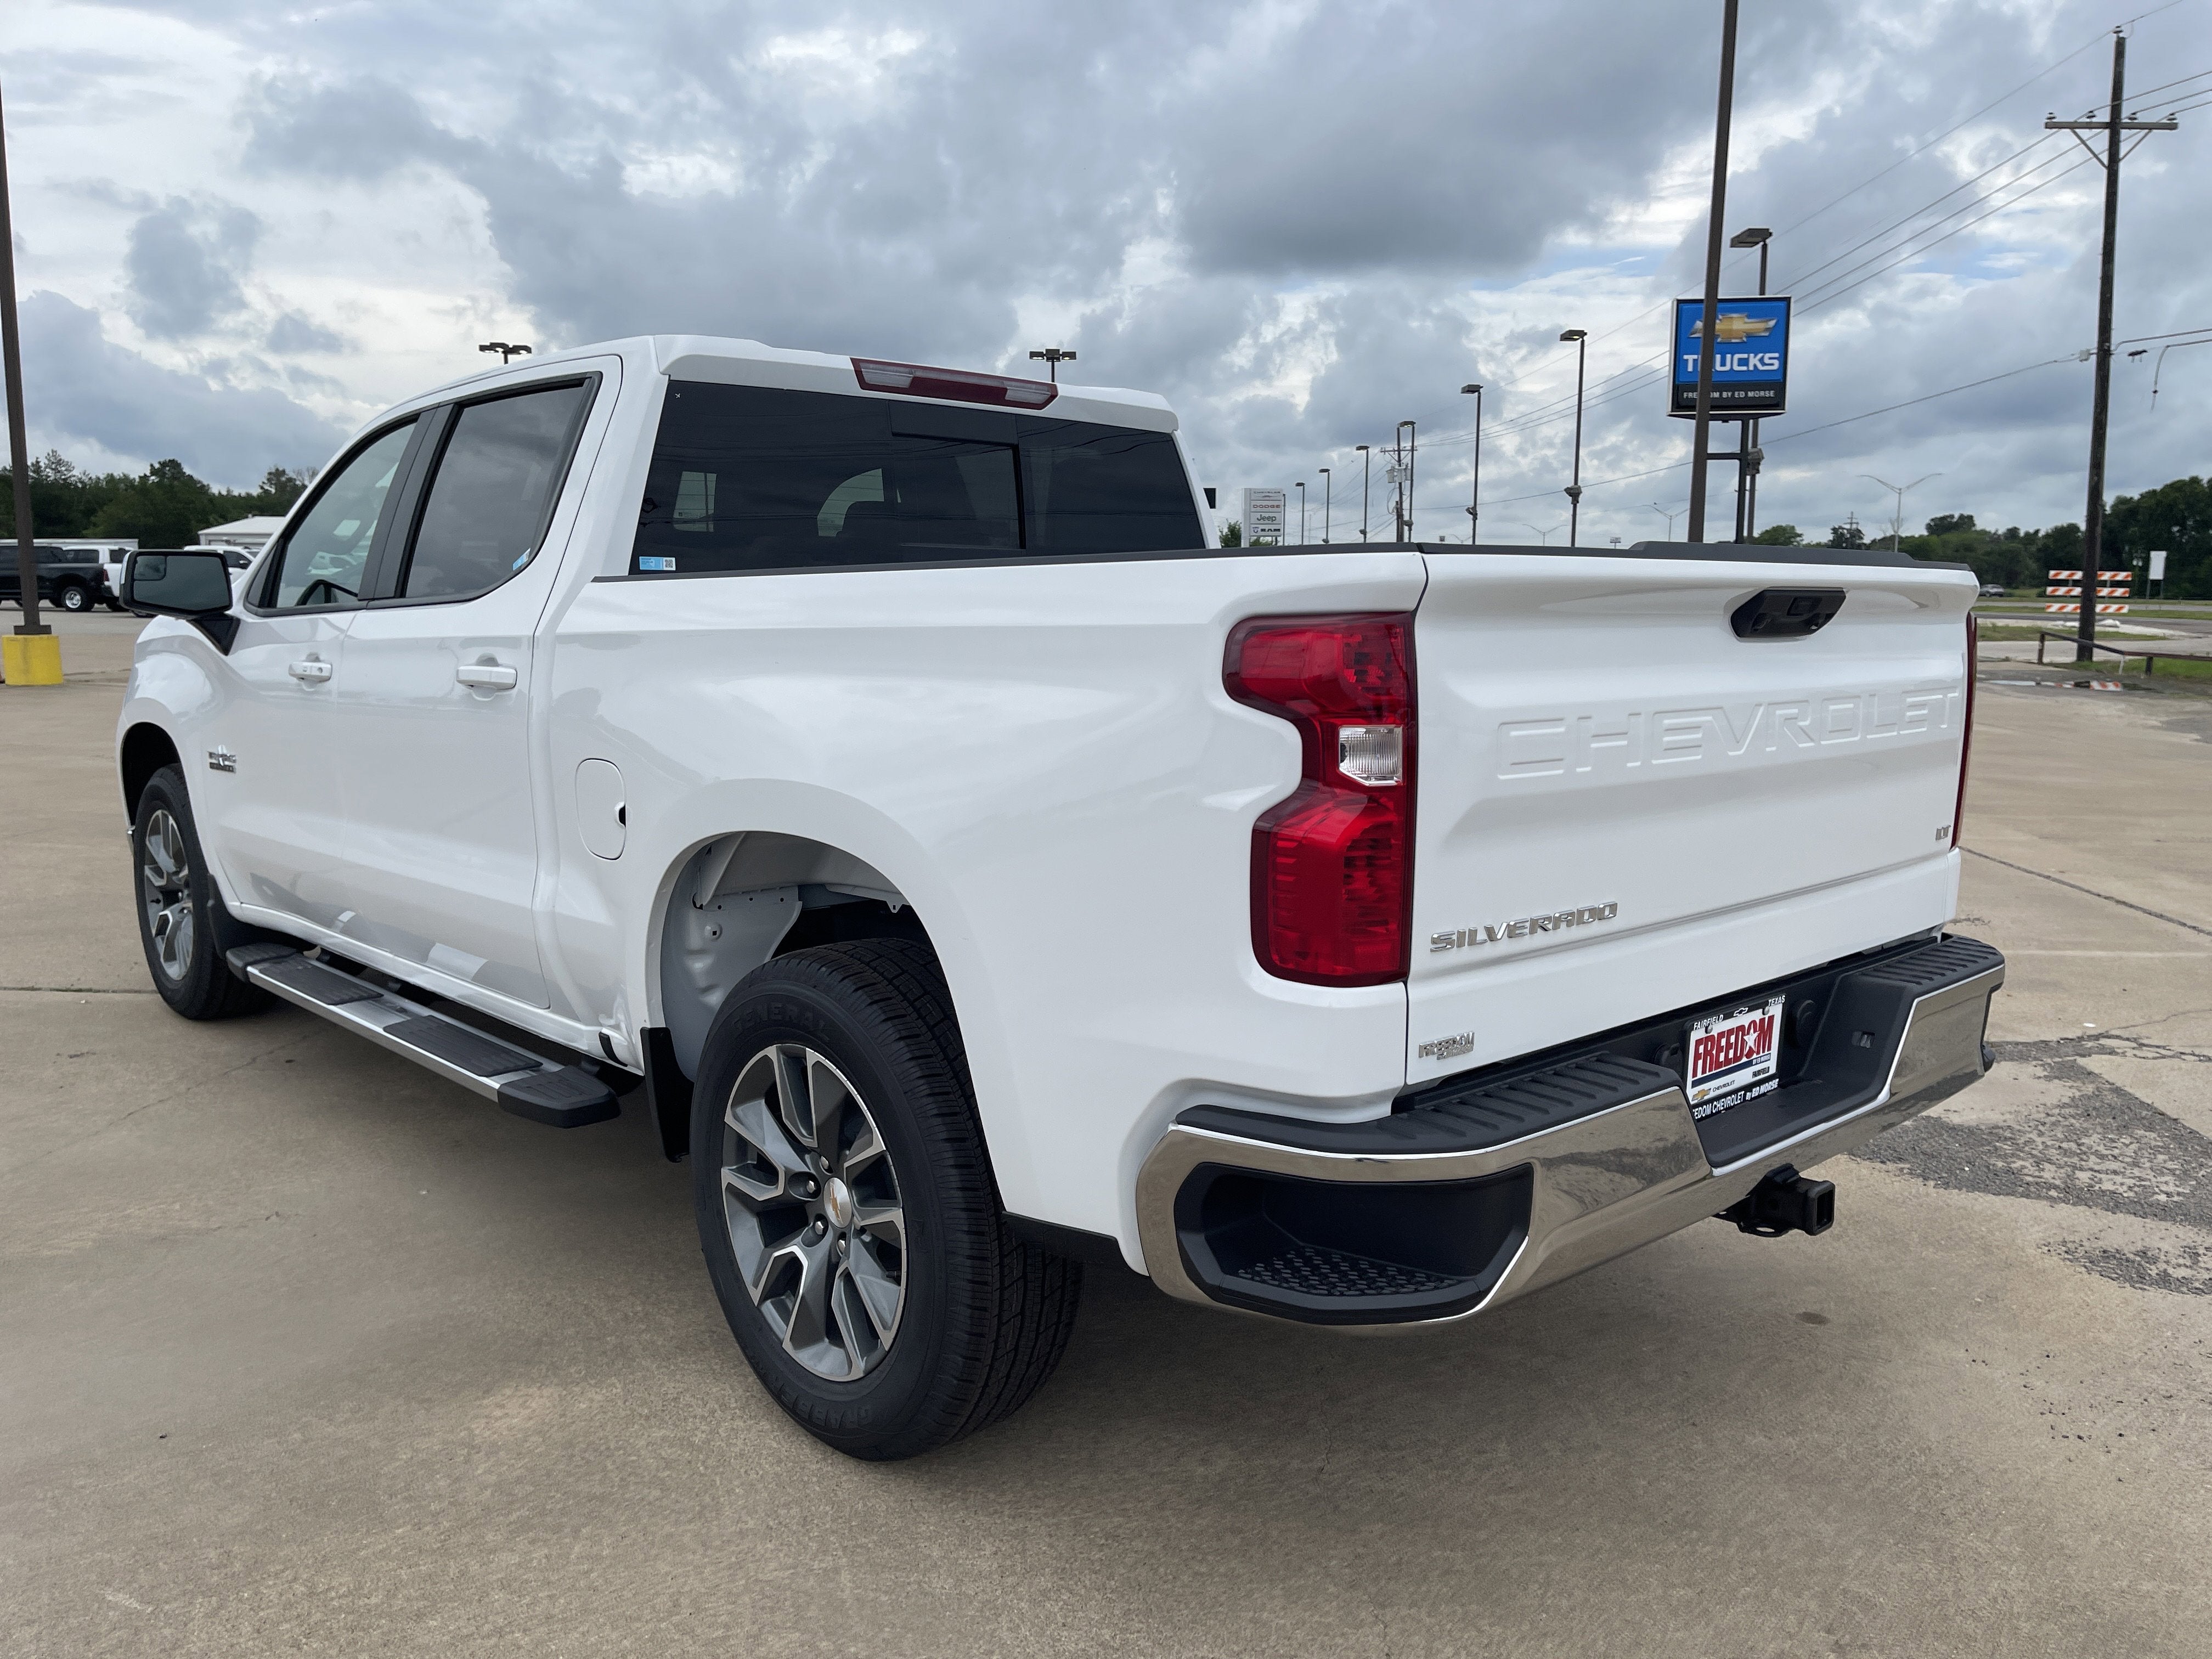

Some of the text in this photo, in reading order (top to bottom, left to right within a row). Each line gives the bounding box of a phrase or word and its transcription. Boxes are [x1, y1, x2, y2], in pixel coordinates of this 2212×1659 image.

[1683, 352, 1780, 372] TUCKS
[1256, 514, 1276, 522] Jeep
[1497, 686, 1960, 780] CHEVROLET
[1935, 825, 1951, 840] LT
[1430, 901, 1618, 952] SILVERADO
[1694, 995, 1786, 1031] FAIRFIELD TEXAS
[1418, 1031, 1475, 1058] FREEDOM
[1691, 1014, 1775, 1079] FREEDOM
[1712, 1080, 1735, 1092] CHEVROLET
[1712, 1091, 1745, 1113] CHEVROLET
[1752, 1086, 1759, 1098] ED
[1759, 1079, 1779, 1094] MORSE
